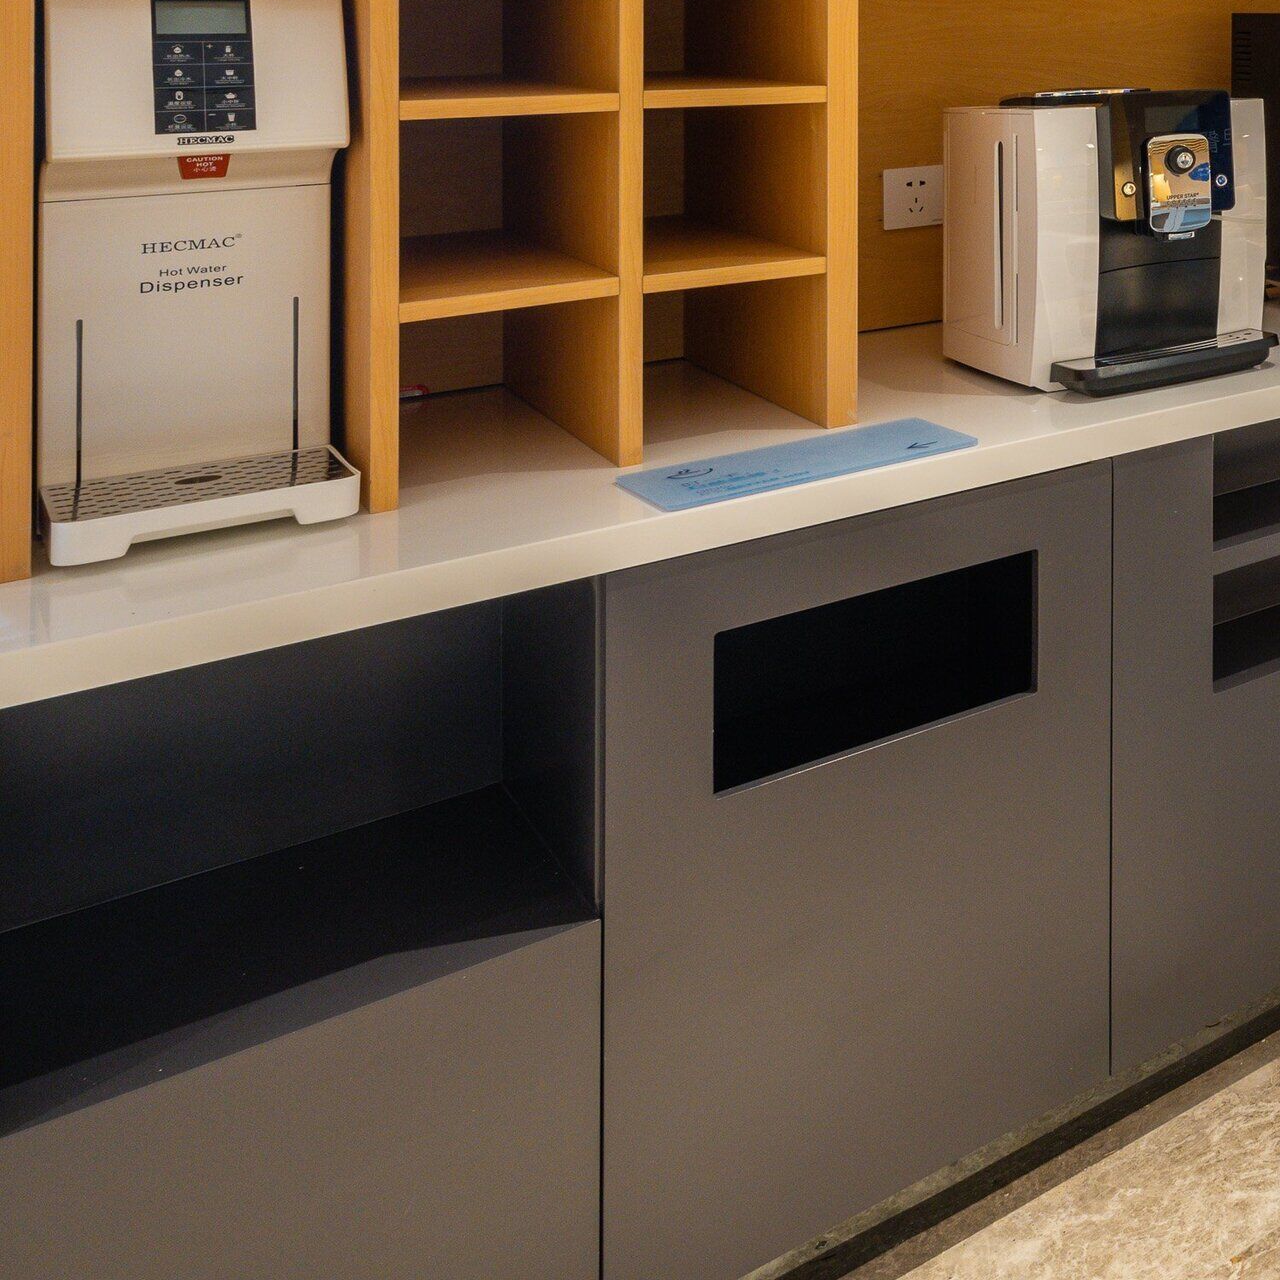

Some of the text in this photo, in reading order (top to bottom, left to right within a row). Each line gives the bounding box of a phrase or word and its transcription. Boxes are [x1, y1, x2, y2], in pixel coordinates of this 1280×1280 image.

[177, 134, 235, 146] HECMAC
[185, 155, 224, 164] CAUTION
[140, 235, 237, 255] HECMAC
[158, 263, 228, 277] Hot Water
[139, 273, 244, 294] Dispenser
